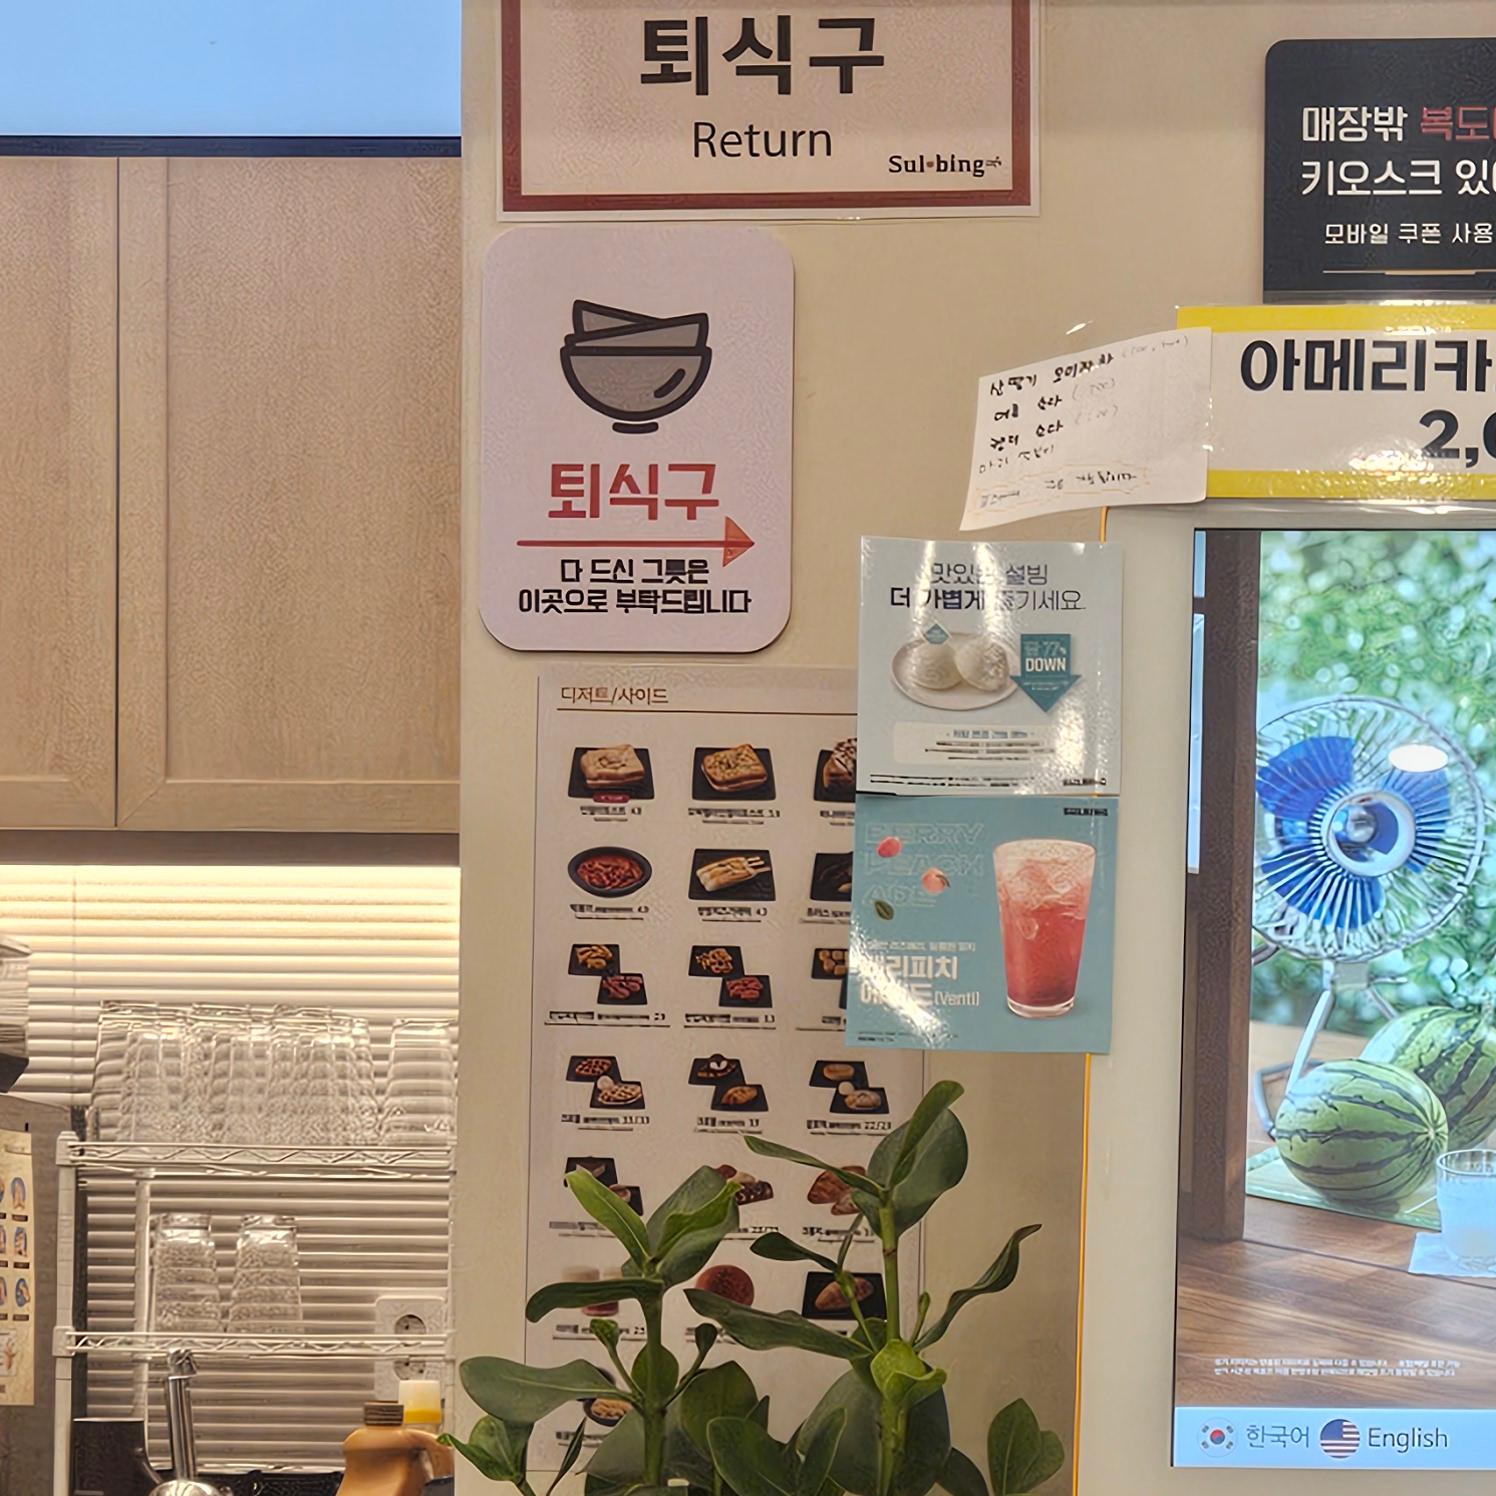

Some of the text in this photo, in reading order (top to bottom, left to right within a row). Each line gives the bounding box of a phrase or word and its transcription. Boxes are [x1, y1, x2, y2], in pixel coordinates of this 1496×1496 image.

[640, 14, 885, 97] 퇴식구
[1301, 105, 1408, 143] 매장밖
[692, 121, 833, 158] Return
[1301, 160, 1442, 197] 키오스크
[1323, 222, 1389, 246] 모바일
[1397, 222, 1442, 245] 쿠폰
[548, 462, 720, 521] 퇴식구
[559, 557, 711, 586] 다 드신 그릇은
[931, 562, 1049, 587] 맛있 설빙
[518, 588, 752, 616] 이곳으로 부탁드립니다
[890, 586, 911, 609] 더
[1025, 657, 1067, 673] DOWN
[560, 686, 670, 706] 디저트/사이드
[1246, 1423, 1311, 1449] 한국어
[1366, 1426, 1449, 1454] English
